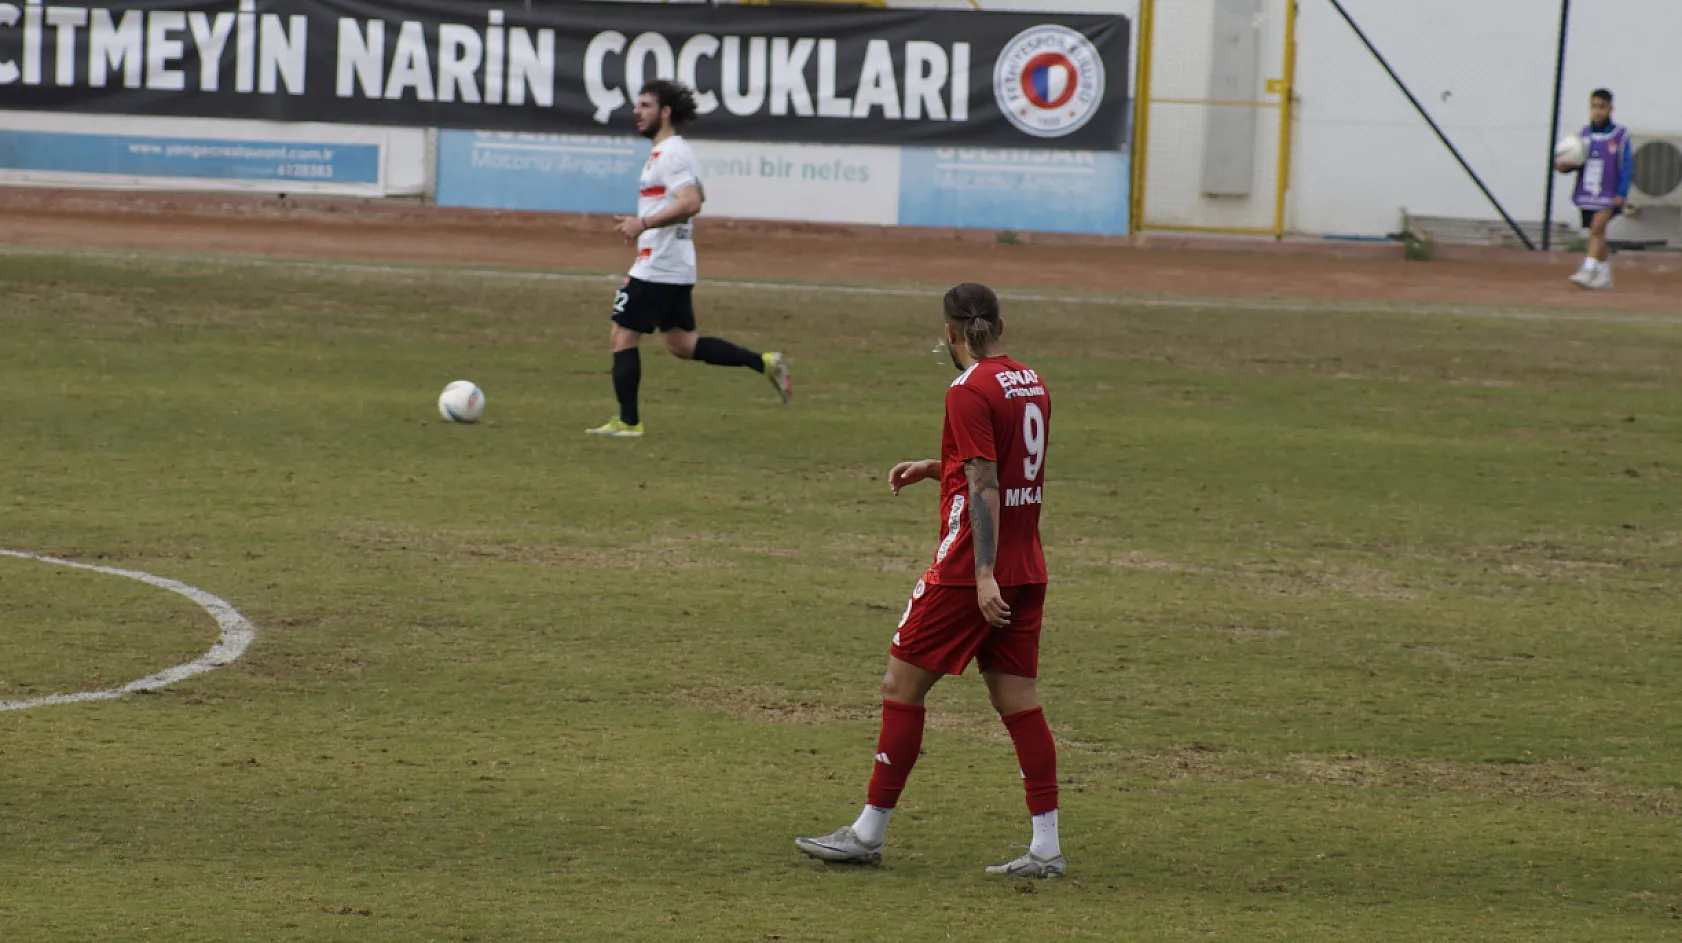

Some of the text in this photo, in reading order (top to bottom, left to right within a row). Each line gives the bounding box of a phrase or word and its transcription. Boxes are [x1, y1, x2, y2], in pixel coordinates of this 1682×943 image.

[336, 10, 555, 107] NARİN
[583, 30, 971, 123] ÇOCUKLARI
[701, 155, 870, 182] yeni bir nefes
[1023, 402, 1045, 481] 9
